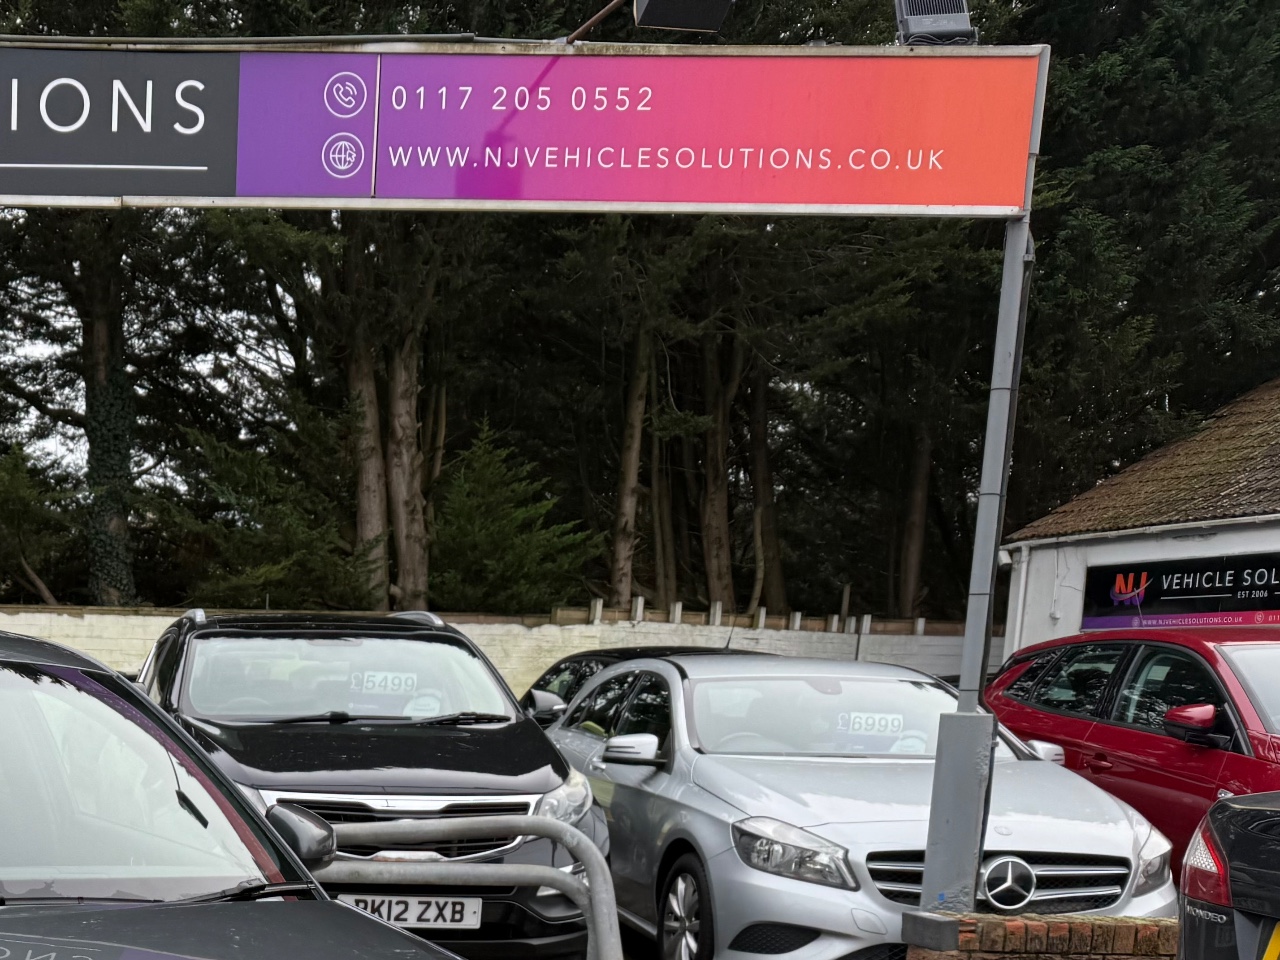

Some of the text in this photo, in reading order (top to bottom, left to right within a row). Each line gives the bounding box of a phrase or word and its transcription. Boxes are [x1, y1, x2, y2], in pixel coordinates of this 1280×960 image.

[391, 86, 653, 112] 0117 205 0552
[389, 146, 945, 171] WWW.NJVEHICLESOLUTIONS.CO.UK
[1113, 571, 1148, 606] NJ
[1162, 568, 1280, 590] VEHICLE SOL
[1237, 590, 1269, 599] EST 2006
[1143, 616, 1243, 626] WWW.NJVEHICLESOLUTIONS.CO.UK
[350, 672, 416, 692] £5499
[837, 712, 903, 733] £6999
[417, 901, 466, 923] ZXB
[1186, 905, 1227, 923] MONDEO
